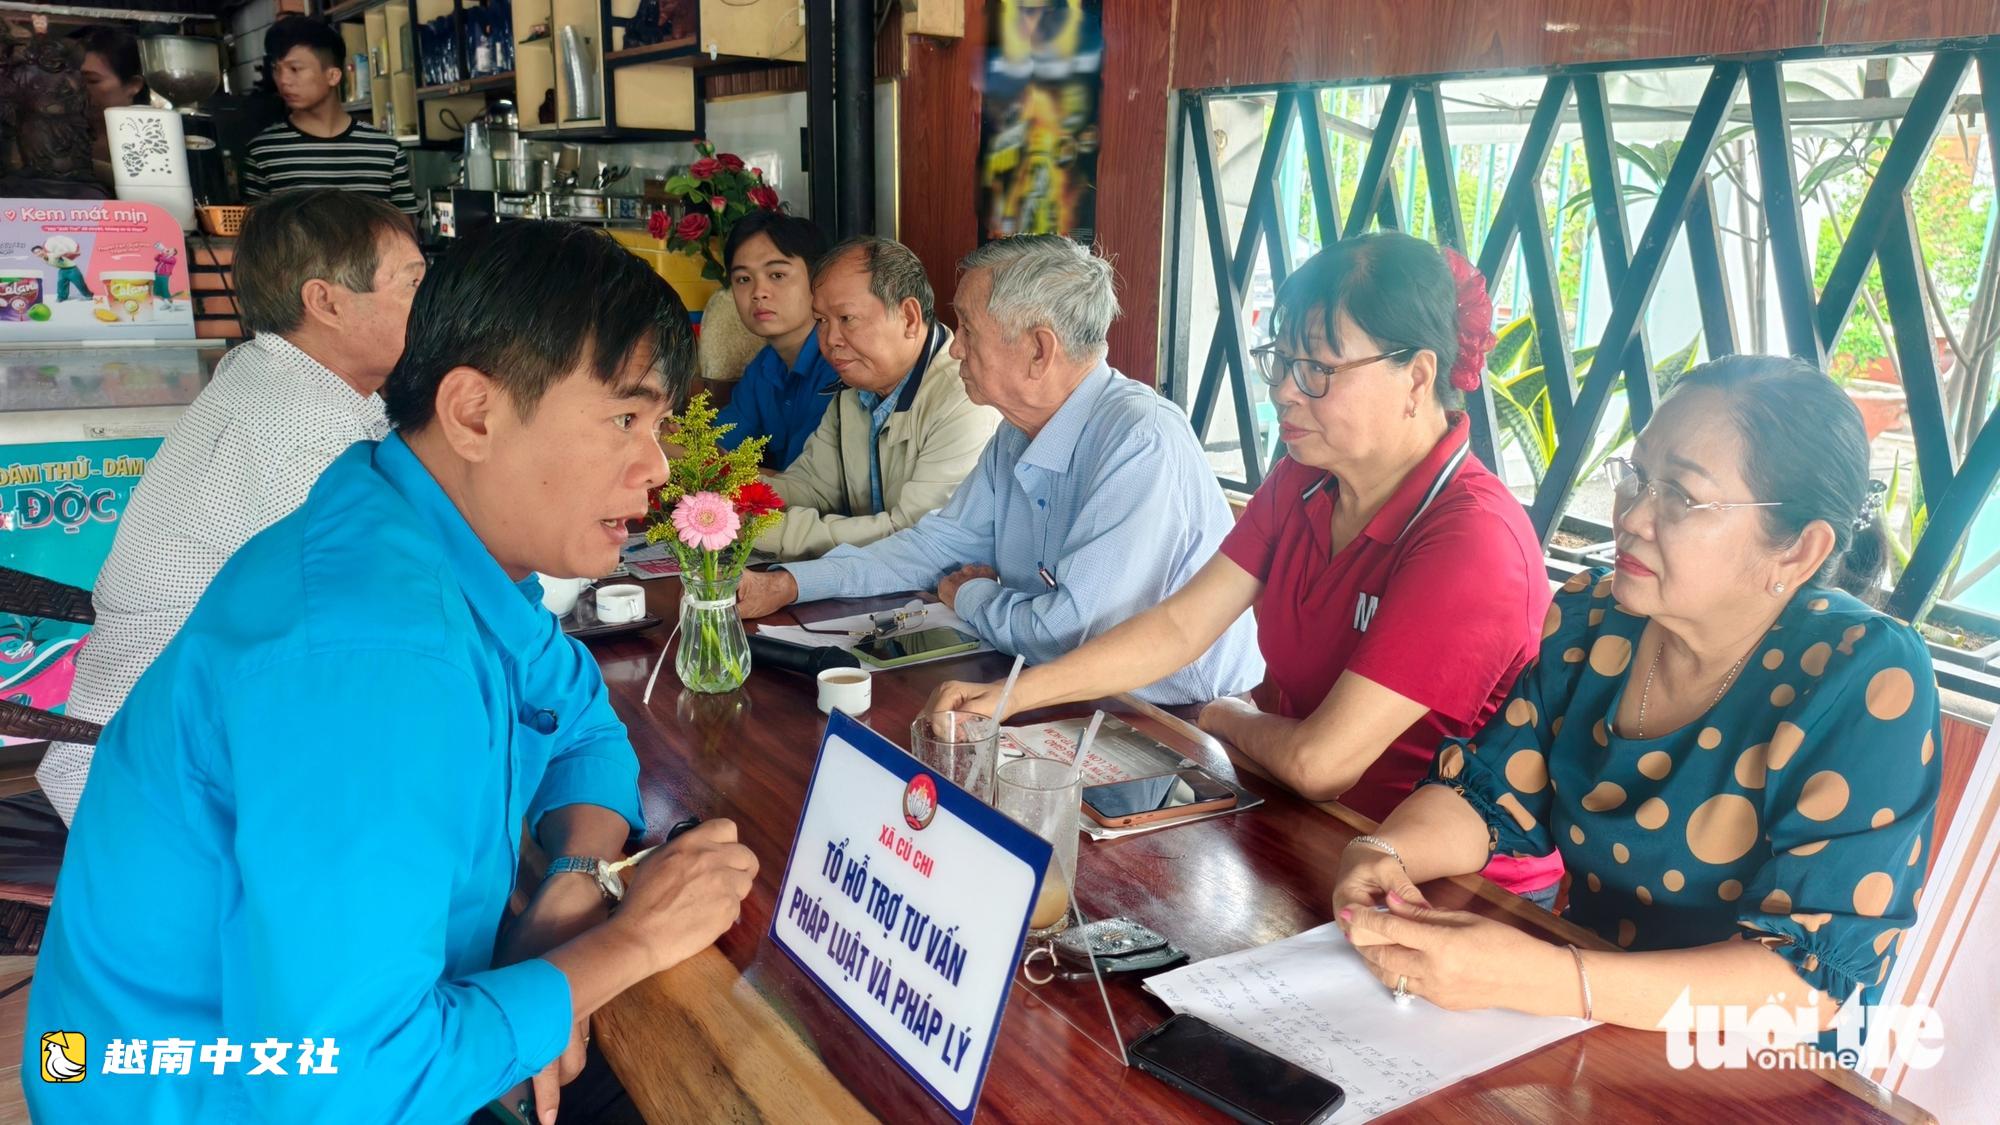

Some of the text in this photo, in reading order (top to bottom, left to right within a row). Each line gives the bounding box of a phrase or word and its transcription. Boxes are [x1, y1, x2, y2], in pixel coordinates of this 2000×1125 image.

[20, 206, 148, 224] Kem mát mịn
[42, 455, 91, 482] THỬ
[14, 482, 117, 534] ĐỘC
[878, 824, 935, 878] XÃ CỦ CHI
[822, 837, 968, 987] TỔ HỖ TRỢ TƯ VẤN
[788, 886, 972, 1073] PHÁP LUẬT VÀ PHÁP LÝ
